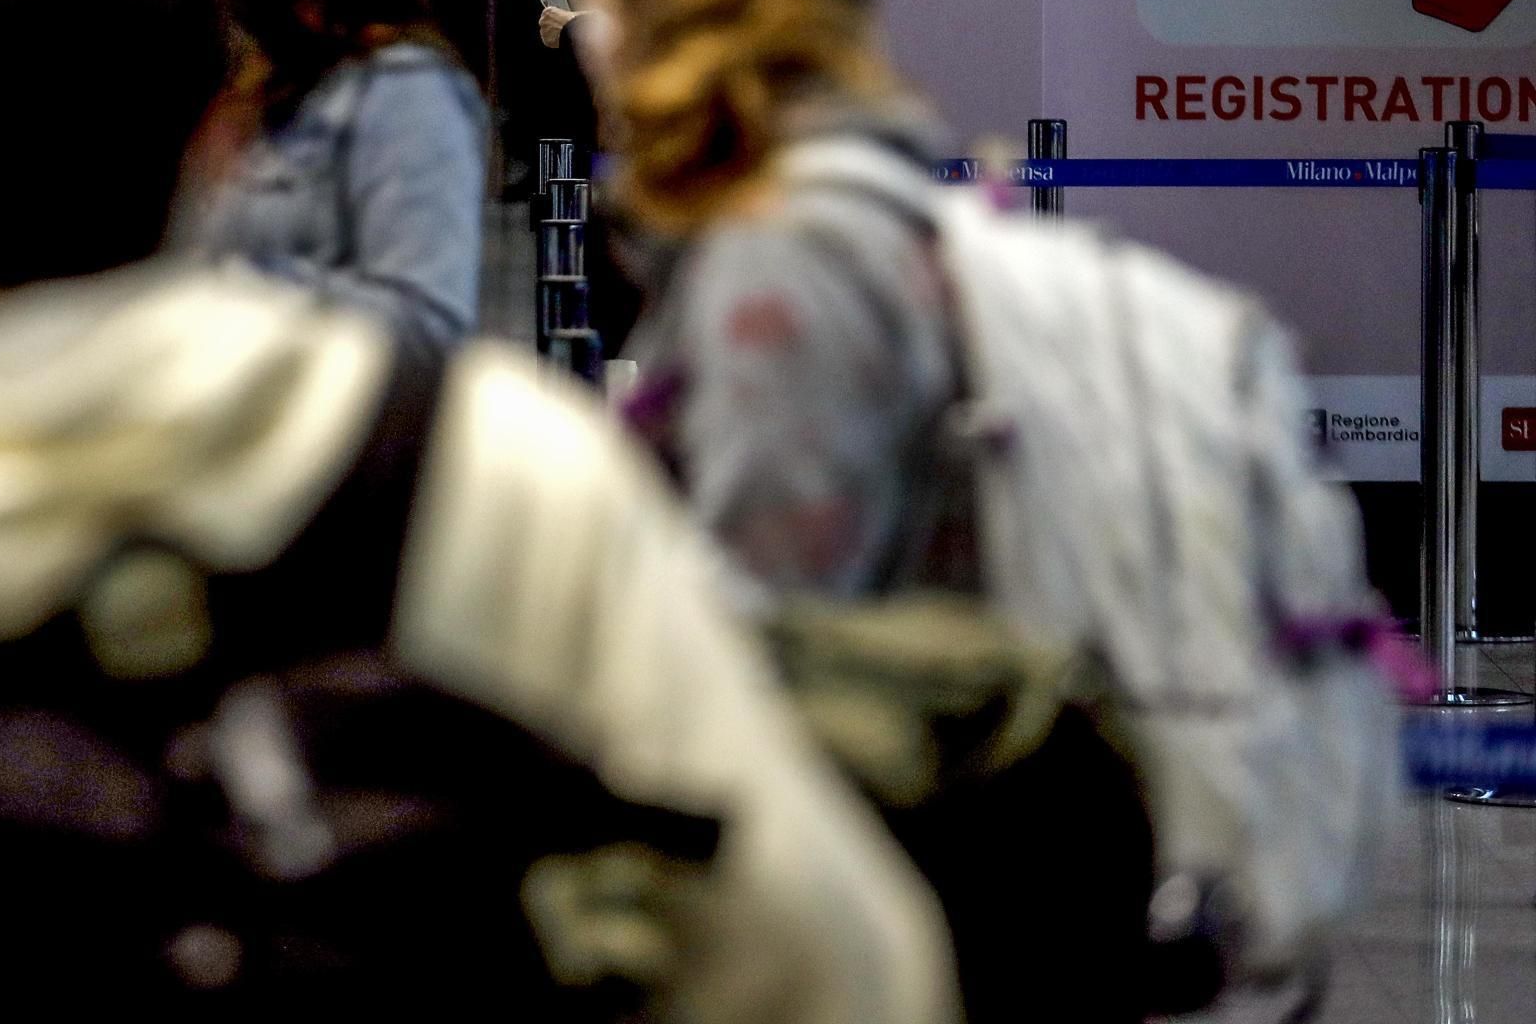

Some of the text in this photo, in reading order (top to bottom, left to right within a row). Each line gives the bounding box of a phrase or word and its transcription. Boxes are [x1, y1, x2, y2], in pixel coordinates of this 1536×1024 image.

[962, 160, 1053, 181] Mensa
[1286, 161, 1417, 185] Milano Malp
[1331, 414, 1400, 430] Regione
[1331, 428, 1420, 442] Lombardia
